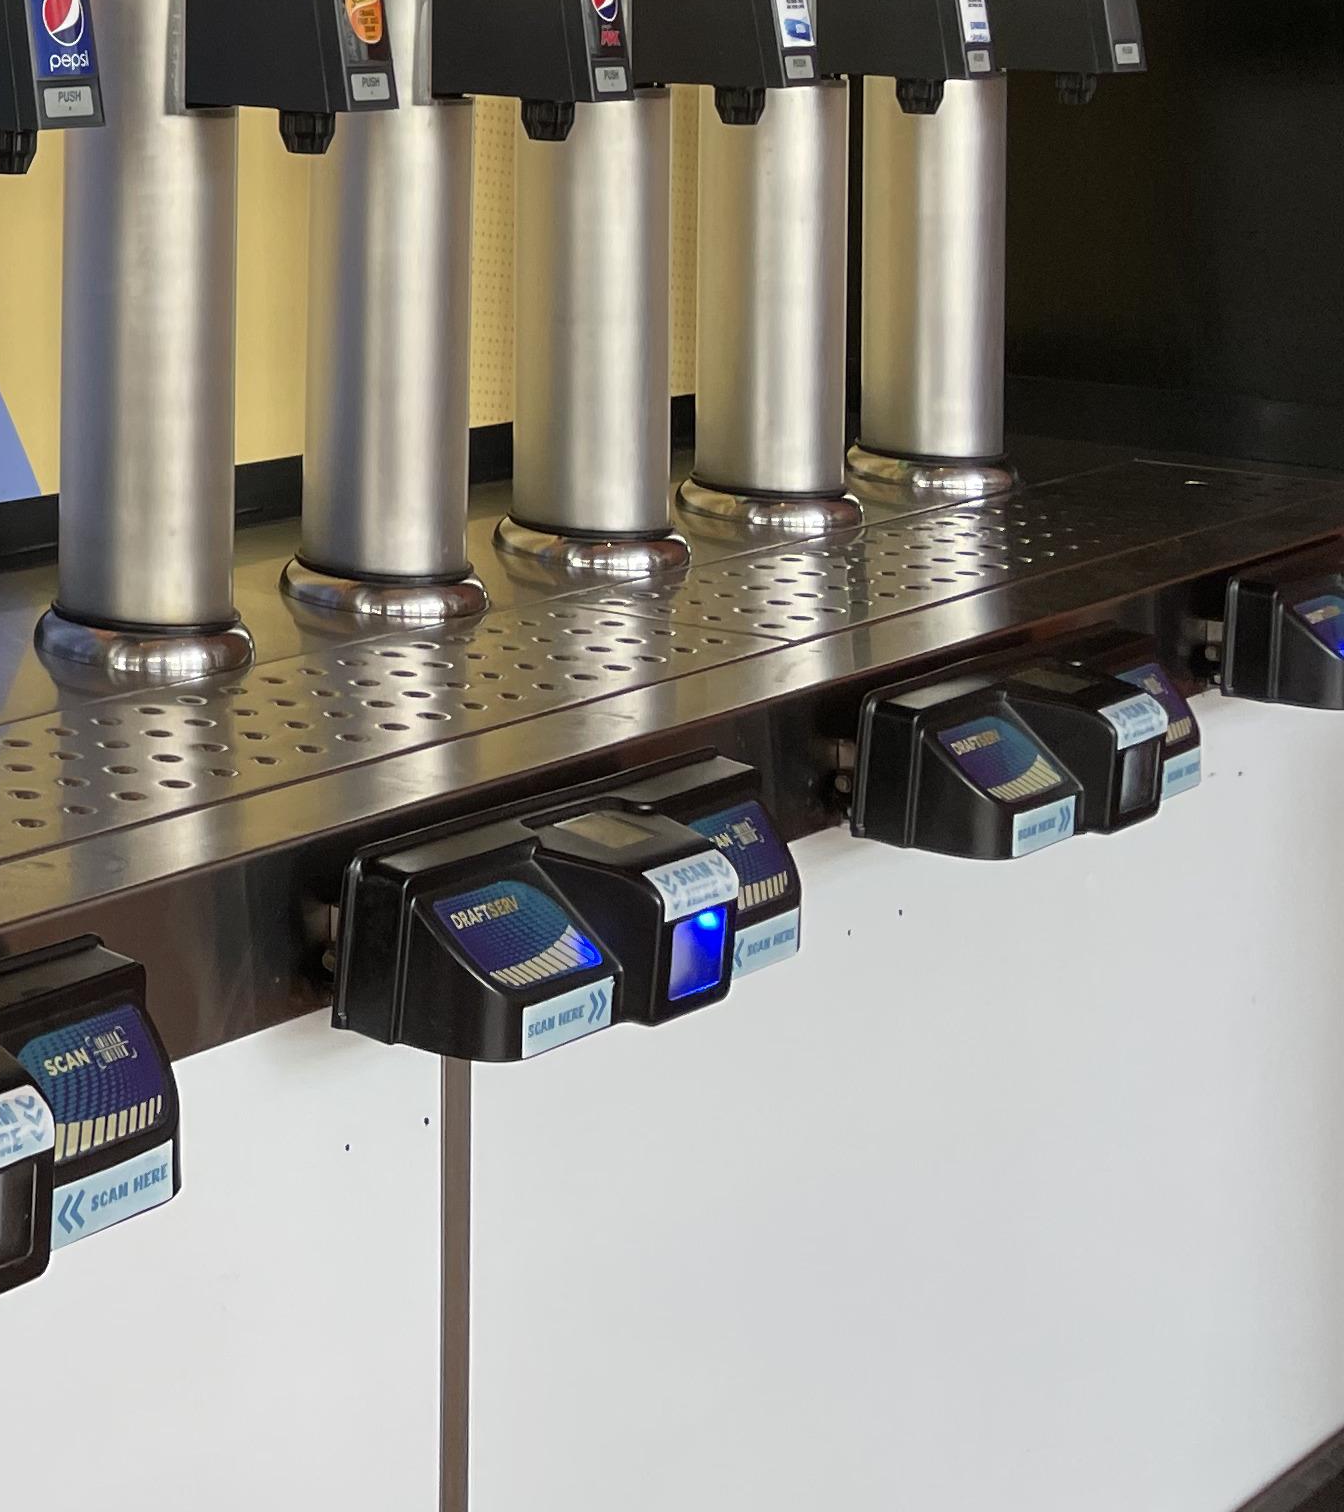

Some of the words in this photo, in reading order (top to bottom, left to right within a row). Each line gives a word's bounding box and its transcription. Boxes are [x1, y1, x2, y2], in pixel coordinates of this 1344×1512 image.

[50, 50, 89, 71] pepsi
[58, 90, 81, 103] PUSH
[362, 77, 380, 87] PUSH
[450, 895, 519, 930] DRAFTSERV
[528, 1014, 554, 1038] SCAN
[558, 1004, 584, 1024] HERE
[43, 1047, 91, 1077] SCAN
[91, 1181, 128, 1212] SCAN
[133, 1163, 168, 1194] HERE
